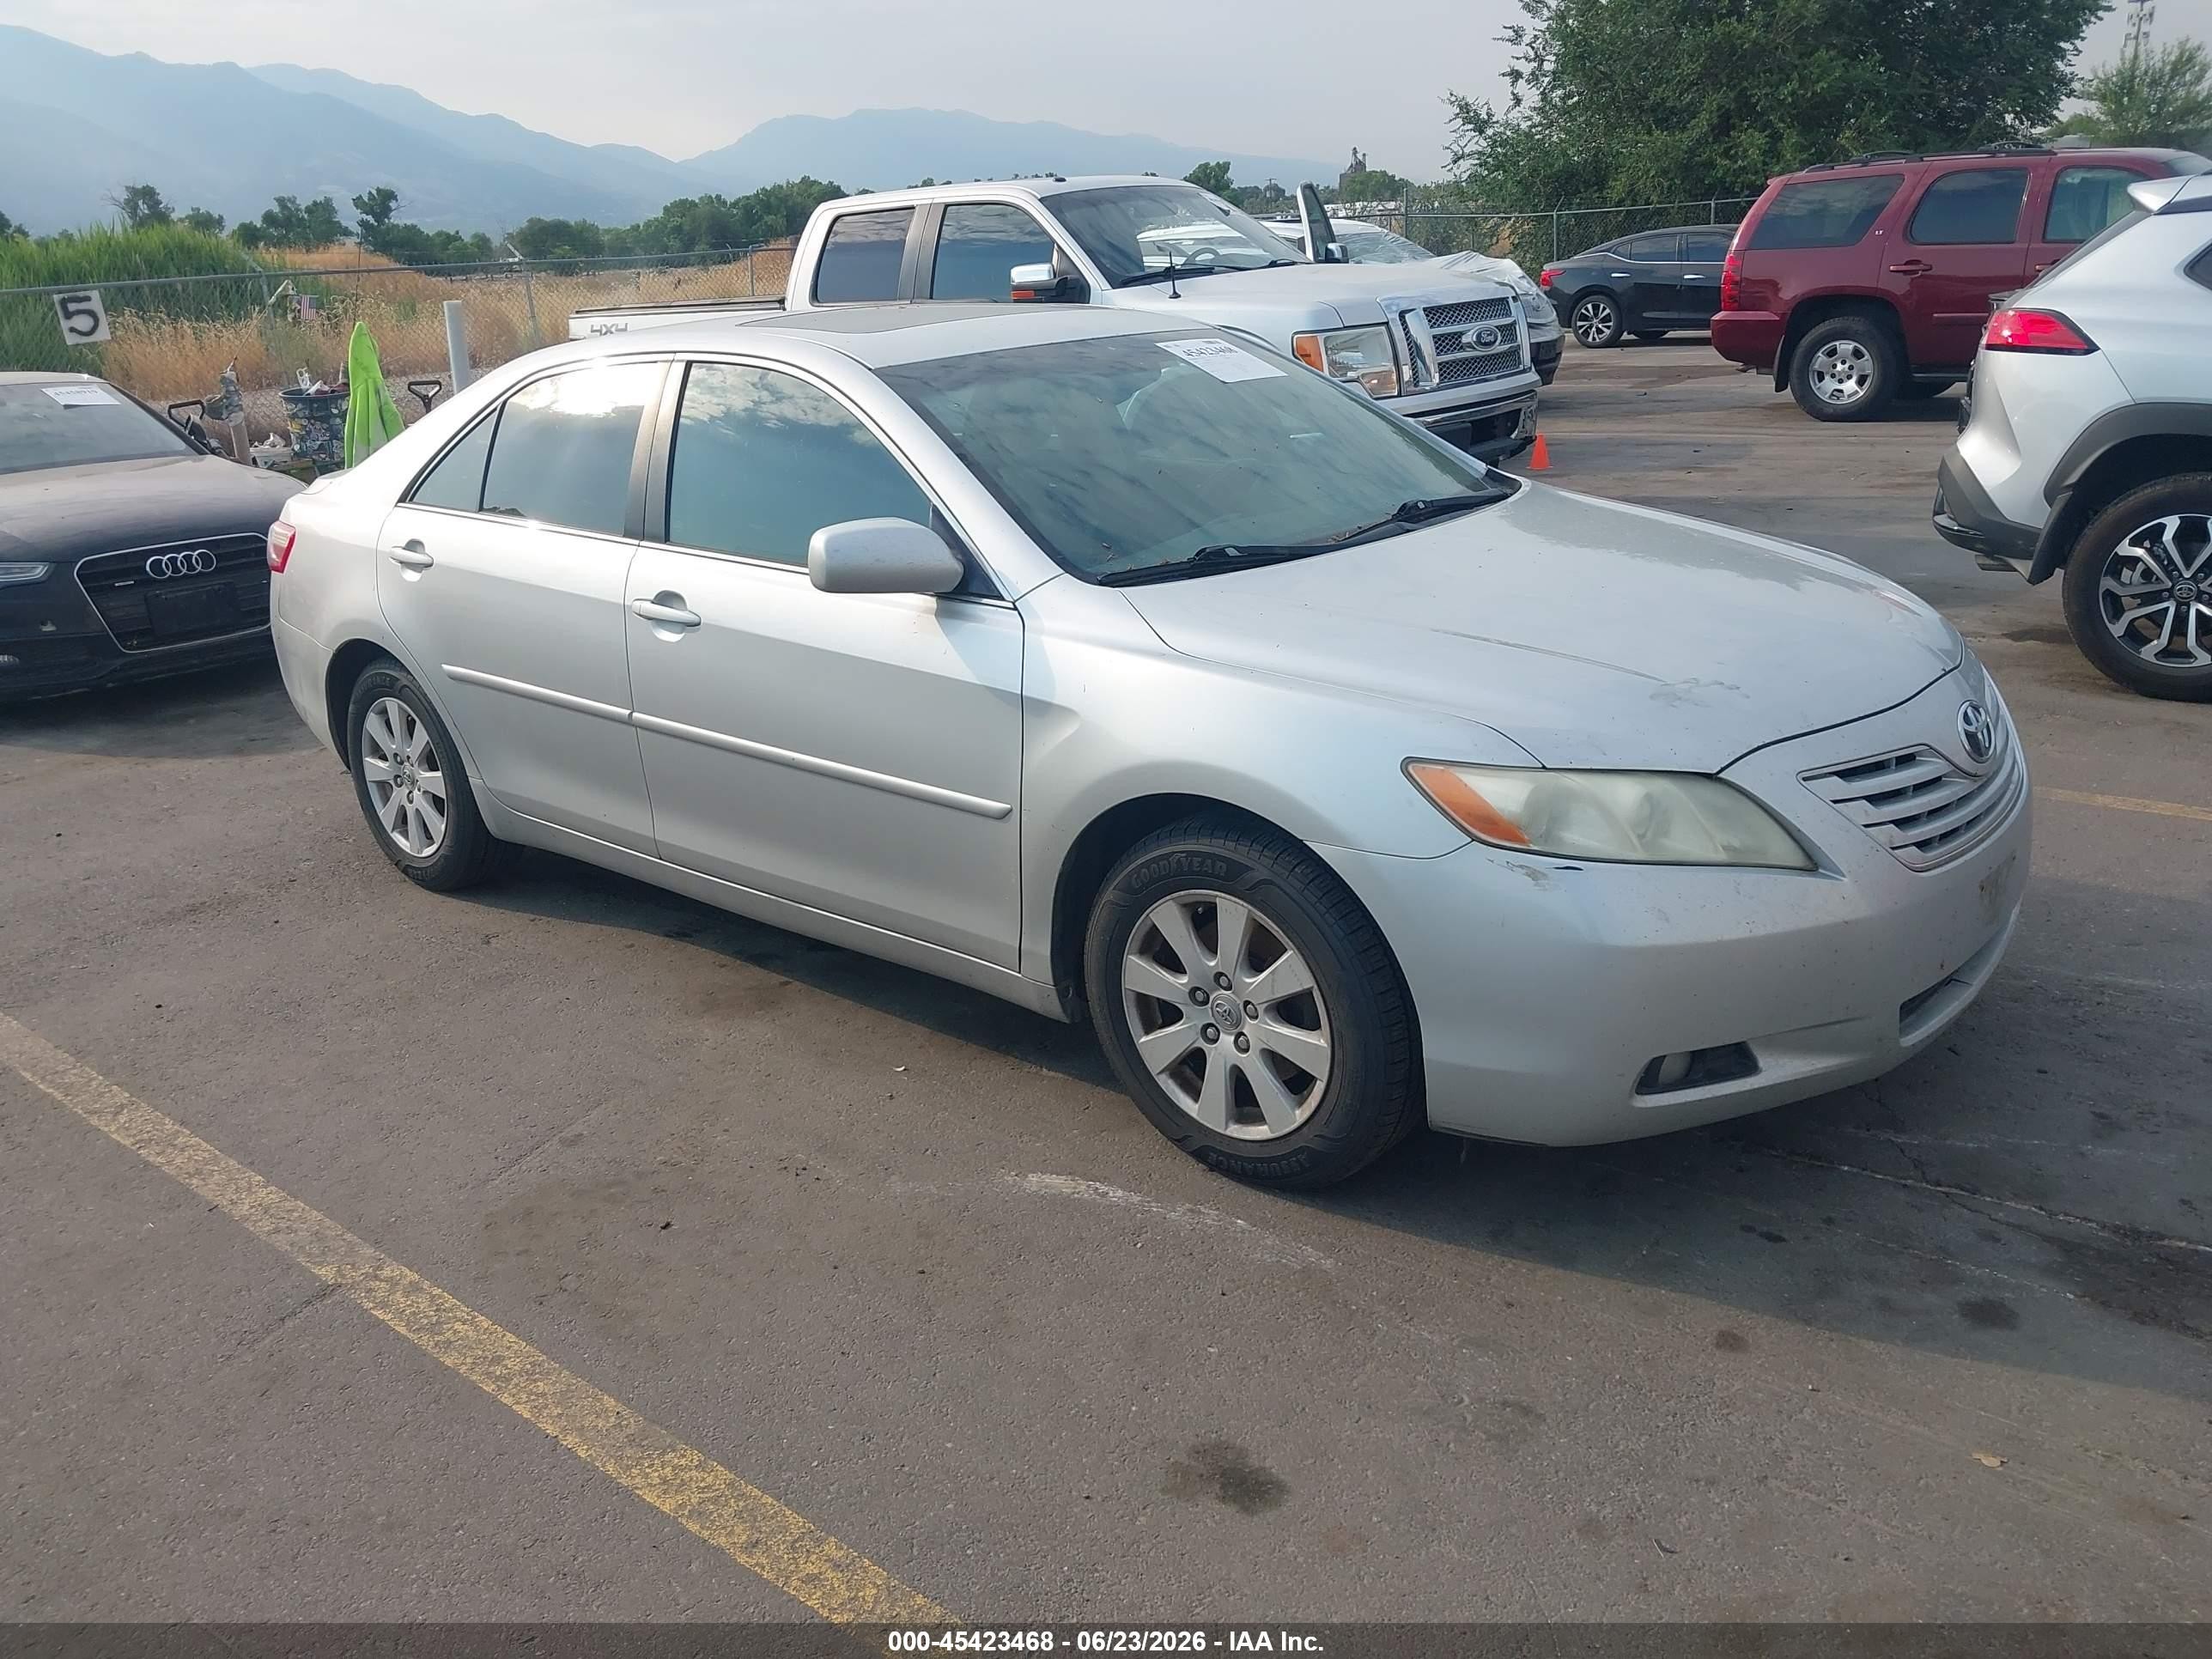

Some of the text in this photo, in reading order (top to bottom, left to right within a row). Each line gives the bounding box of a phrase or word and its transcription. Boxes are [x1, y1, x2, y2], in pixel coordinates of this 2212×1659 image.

[60, 295, 100, 337] 5
[591, 323, 628, 336] 4X4
[1131, 854, 1228, 889] GOODYEAR
